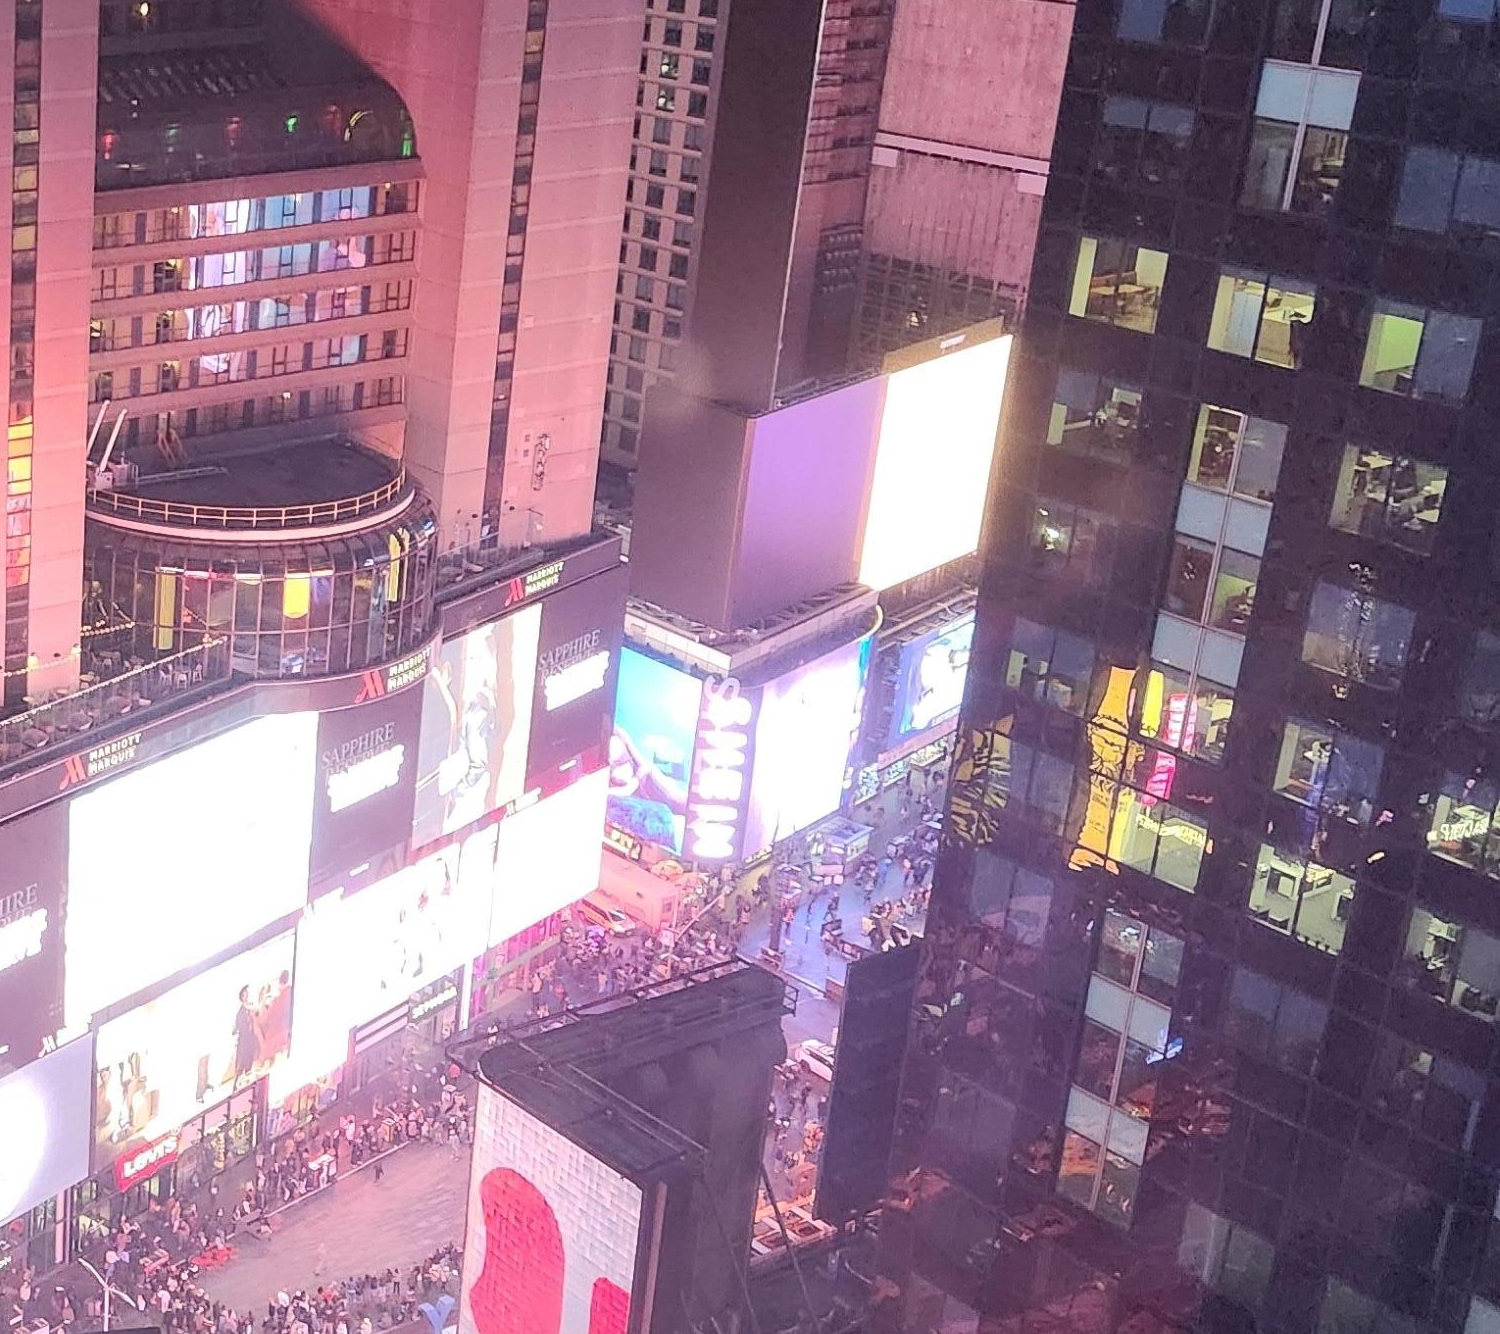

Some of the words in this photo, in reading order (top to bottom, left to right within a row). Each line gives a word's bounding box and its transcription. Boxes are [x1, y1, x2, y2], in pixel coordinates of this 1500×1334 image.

[526, 561, 565, 585] MARRIOTT
[389, 647, 432, 678] MARRIOTT
[540, 628, 600, 668] SAPPHIRE
[387, 666, 427, 692] MARQUIS
[89, 733, 142, 762] MARRIOTT
[322, 722, 395, 768] SAPPHIRE
[87, 746, 137, 777] MARQUIS
